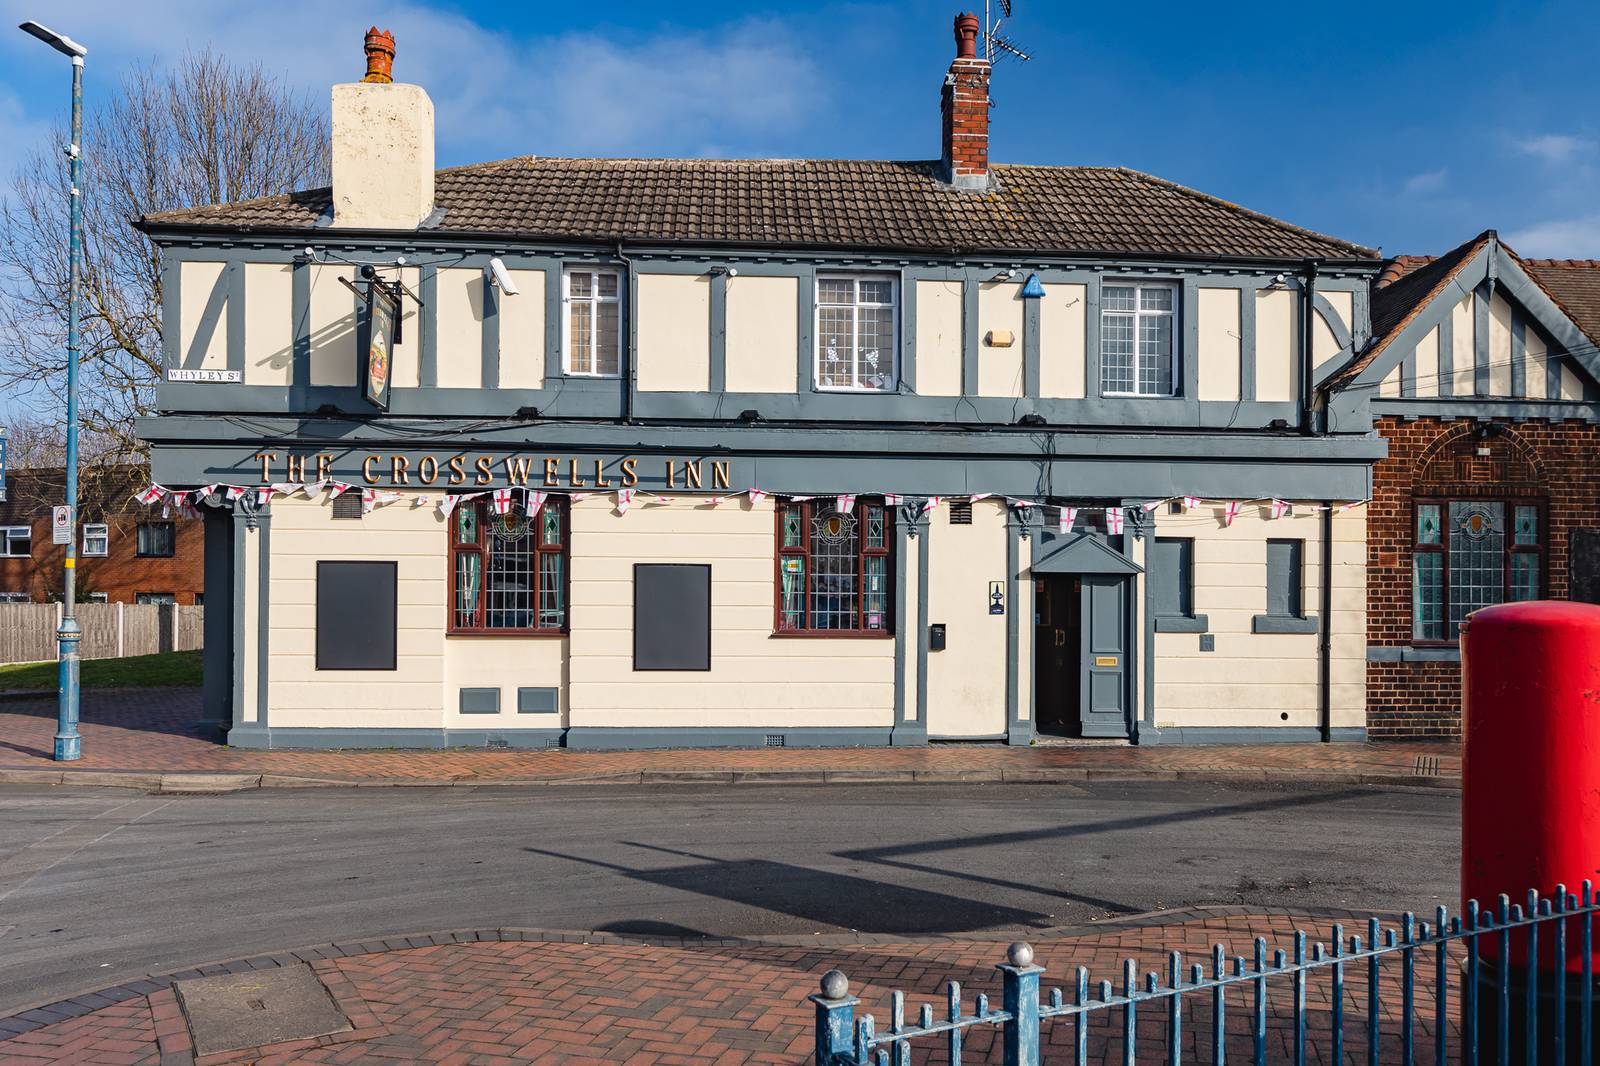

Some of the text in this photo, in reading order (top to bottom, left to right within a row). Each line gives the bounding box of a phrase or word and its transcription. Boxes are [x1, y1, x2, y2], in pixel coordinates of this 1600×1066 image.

[169, 370, 223, 380] WHYLEY
[256, 453, 731, 490] THE CROSSWELLS INN
